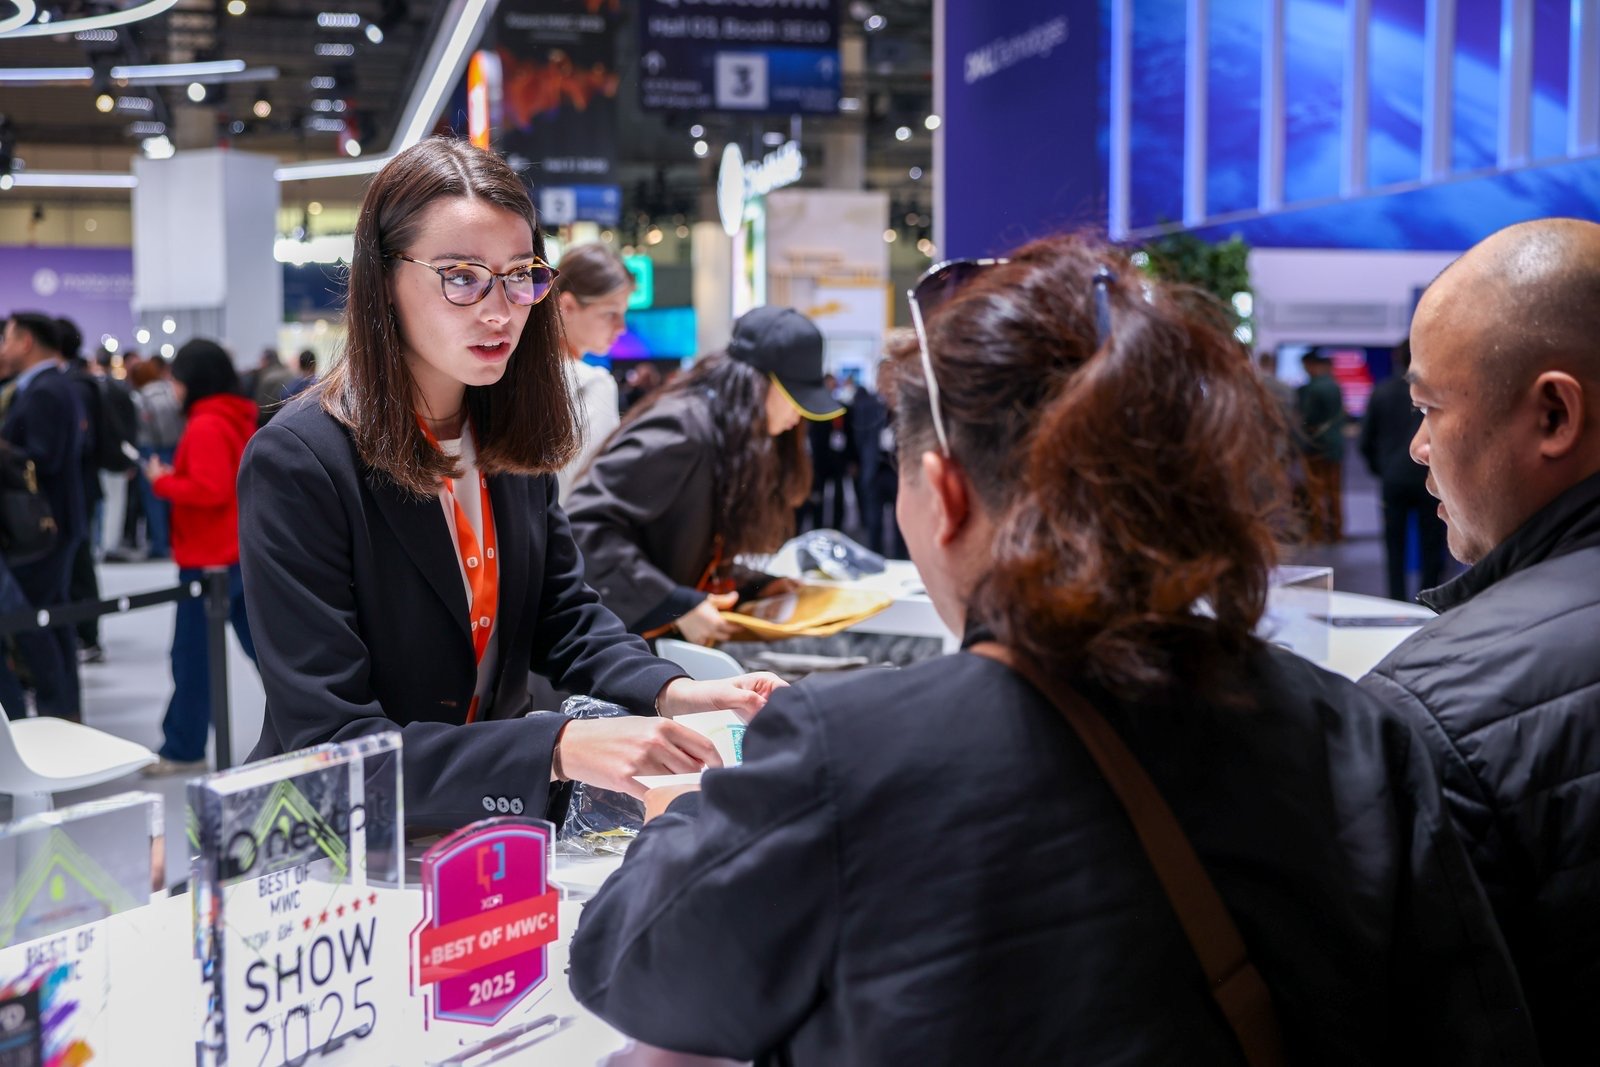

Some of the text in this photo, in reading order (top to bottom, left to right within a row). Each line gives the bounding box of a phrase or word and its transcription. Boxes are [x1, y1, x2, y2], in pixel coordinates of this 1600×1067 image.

[729, 63, 753, 98] 3
[270, 890, 300, 916] MWC
[431, 911, 549, 967] BEST OF MWC
[244, 916, 376, 1013] SHOW
[469, 970, 516, 1007] 2025
